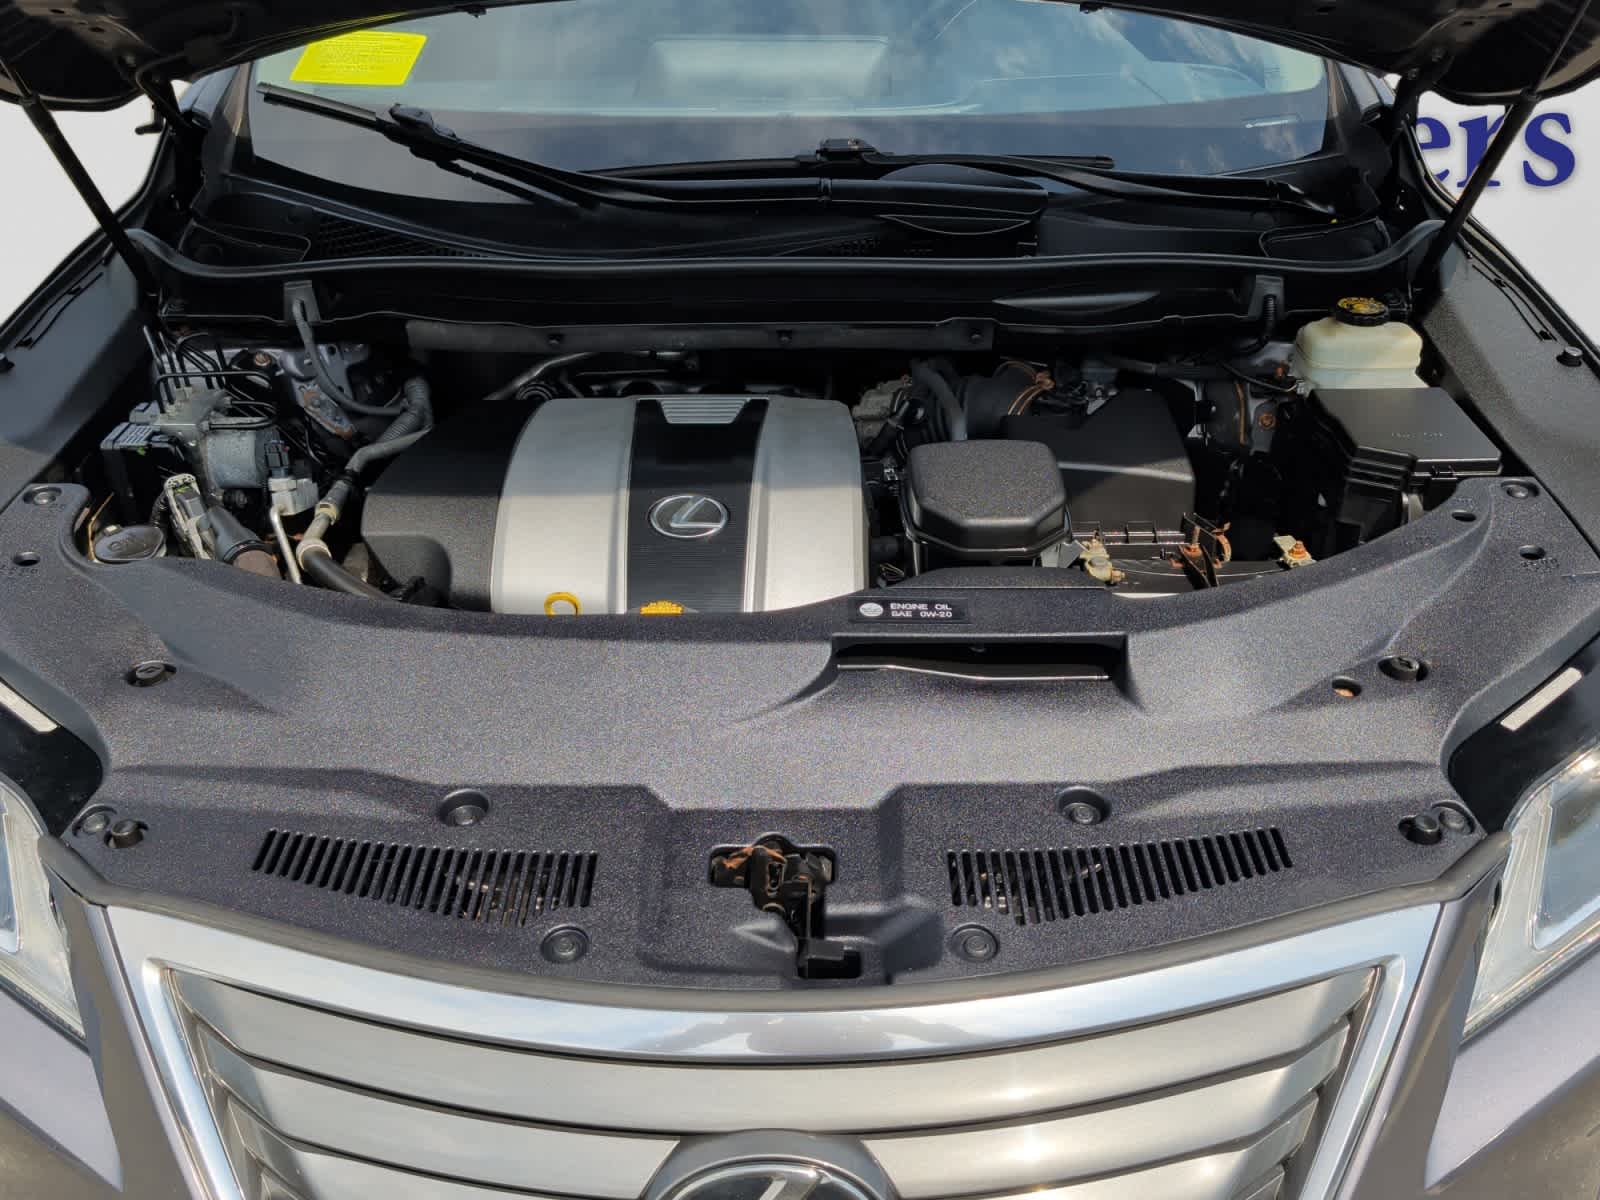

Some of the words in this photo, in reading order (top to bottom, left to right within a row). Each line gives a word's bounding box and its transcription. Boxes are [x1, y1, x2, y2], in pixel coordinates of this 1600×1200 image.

[889, 602, 929, 610] ENGINE
[934, 603, 953, 611] OIL
[890, 610, 913, 618] SAE
[919, 610, 953, 618] 0W-20
